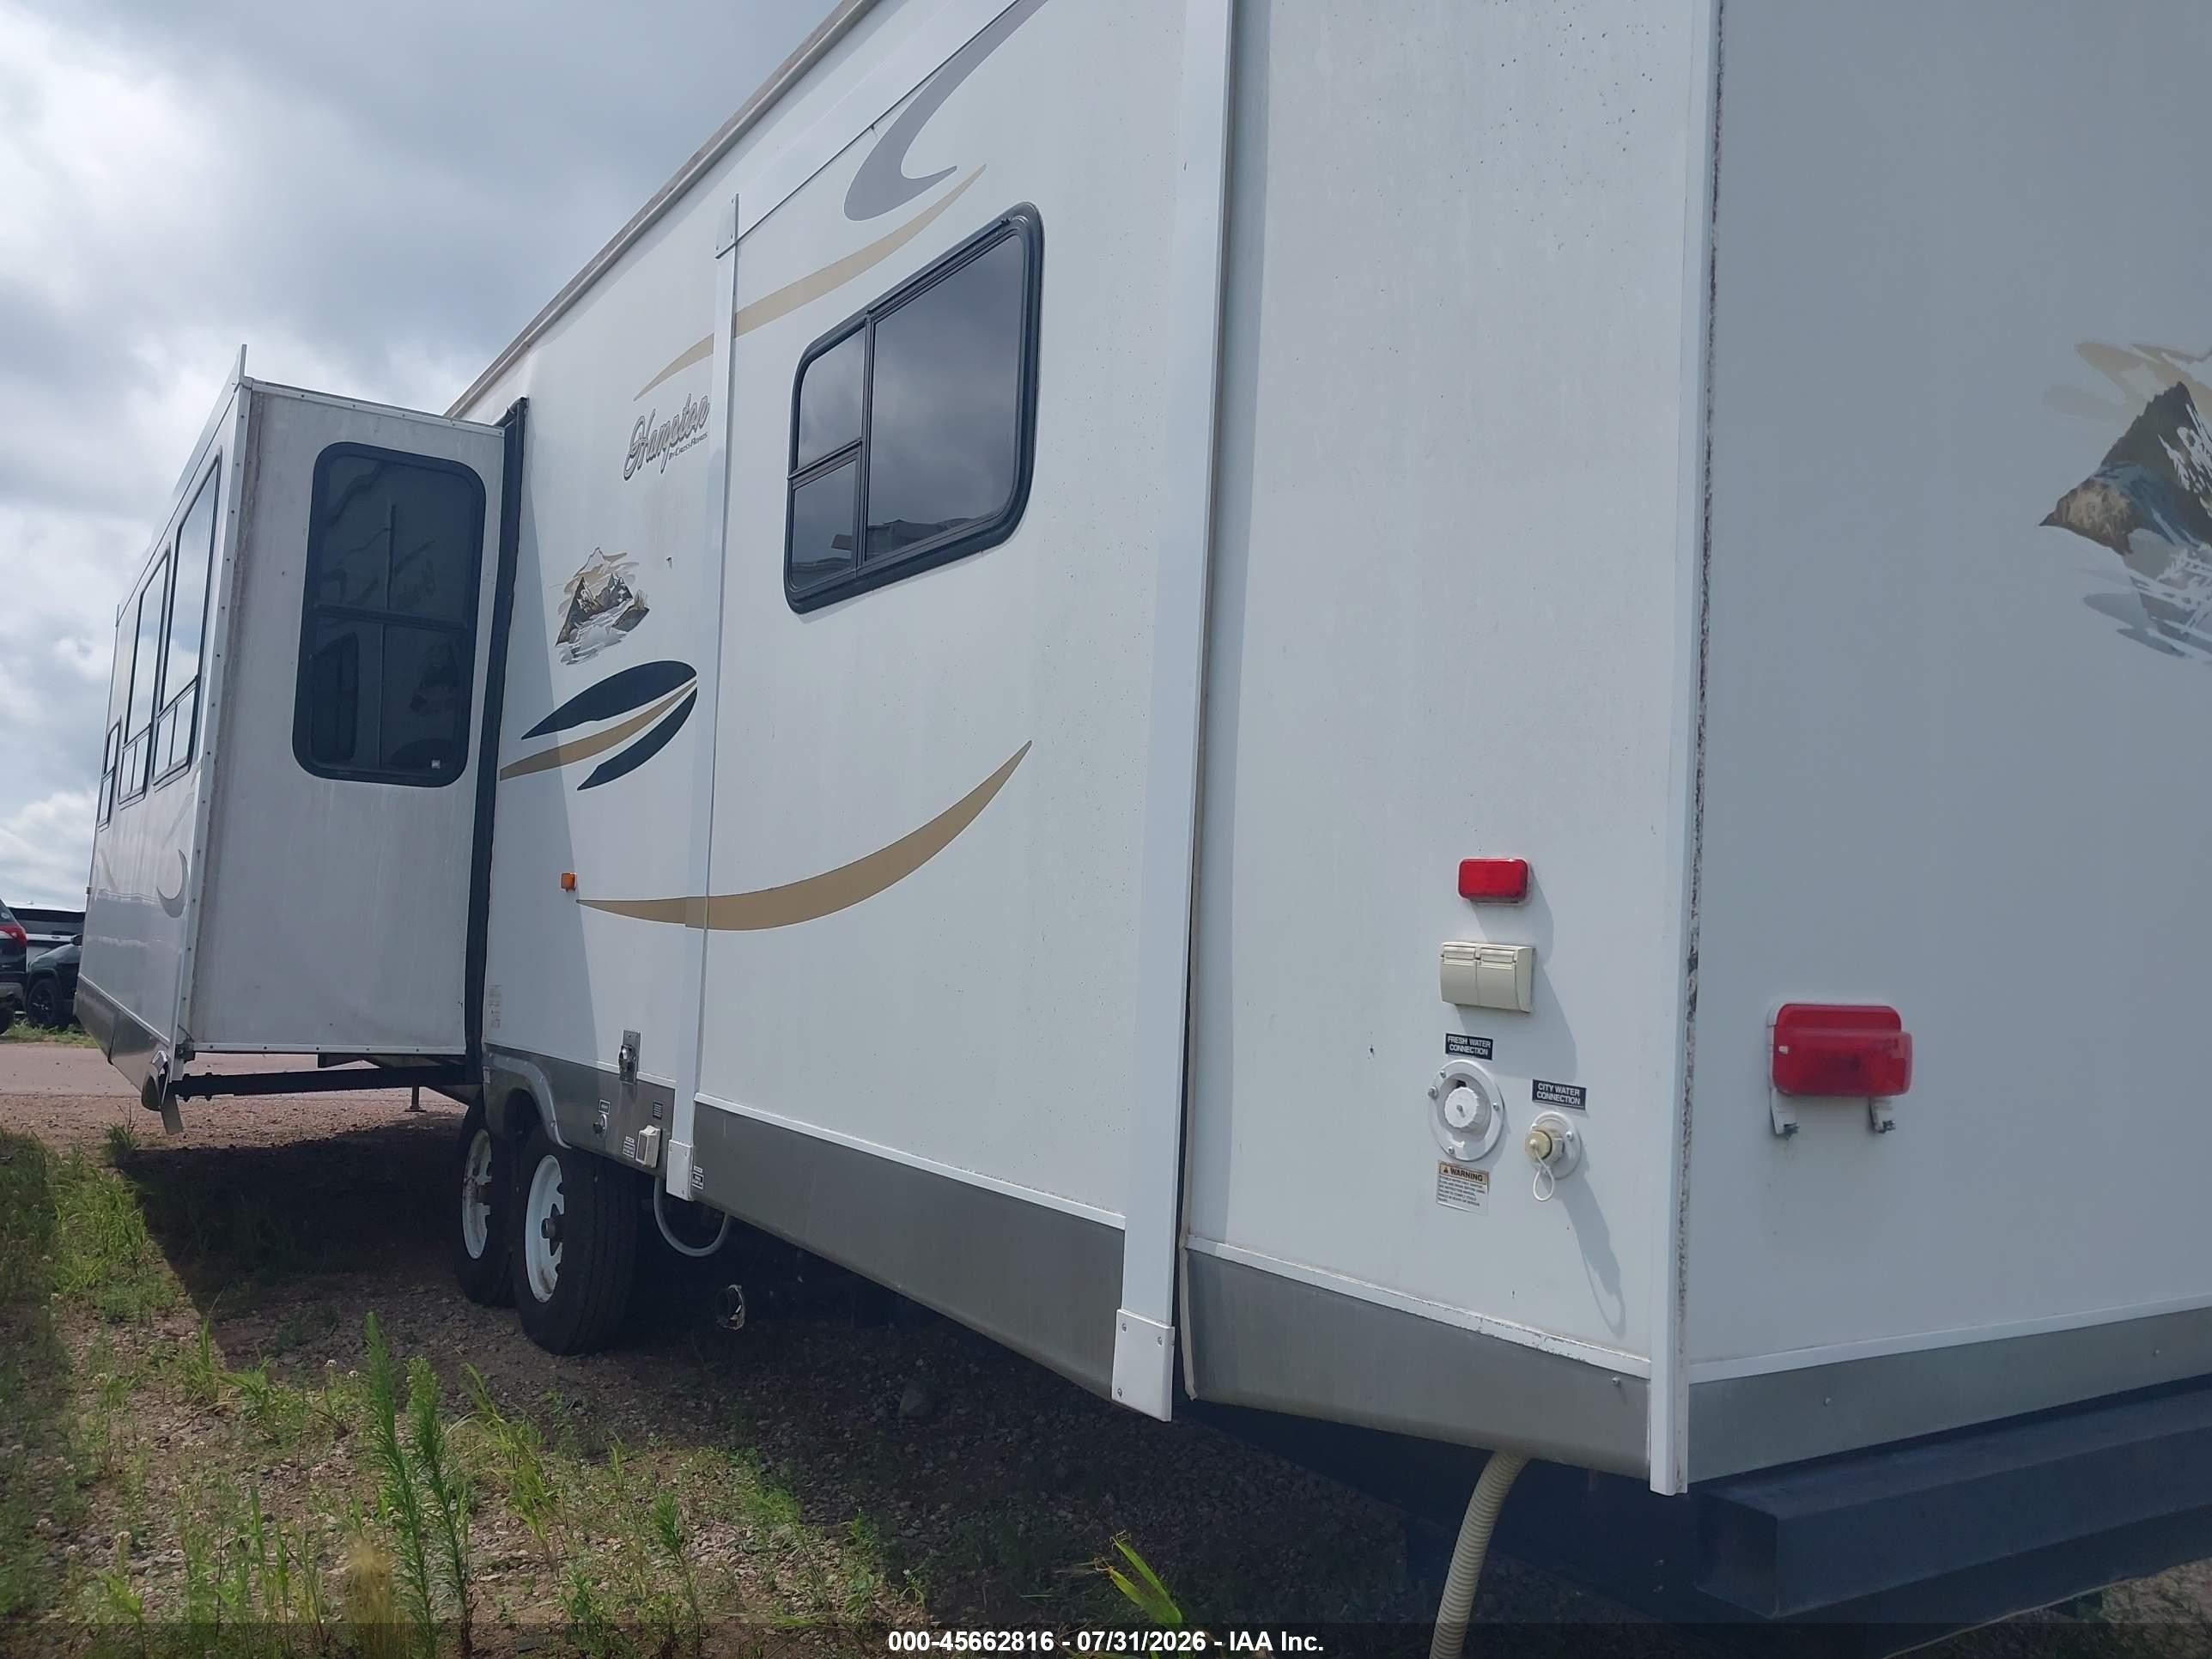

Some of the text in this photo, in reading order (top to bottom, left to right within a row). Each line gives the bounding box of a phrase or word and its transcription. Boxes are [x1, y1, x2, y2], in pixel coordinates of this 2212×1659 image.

[1447, 1035, 1492, 1048] FRESH WATER
[1449, 1043, 1489, 1056] CONNECTION
[1538, 1083, 1581, 1097] CITY WATER
[1536, 1091, 1581, 1105] CONNECTION
[1449, 1167, 1483, 1182] WARNING
